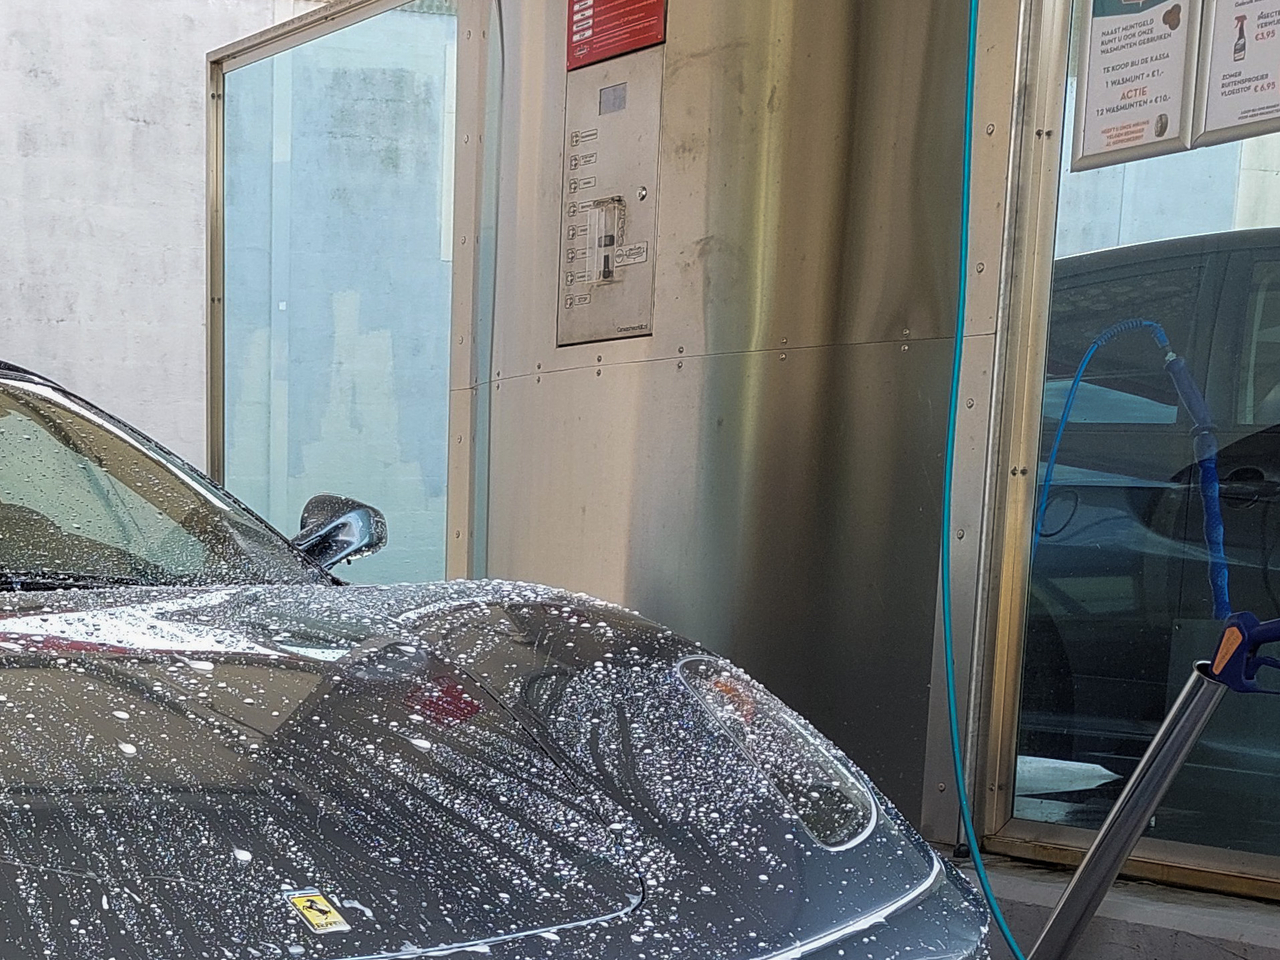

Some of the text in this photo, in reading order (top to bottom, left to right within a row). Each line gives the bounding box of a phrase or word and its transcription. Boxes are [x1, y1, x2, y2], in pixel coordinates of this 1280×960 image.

[1101, 18, 1154, 37] NAAST MUNTGELD
[1100, 36, 1117, 47] KUNT
[1123, 32, 1137, 41] OOK
[1137, 27, 1154, 37] ONZE
[1100, 32, 1172, 55] WASMUNTEN GEBRUIKEN
[1111, 61, 1129, 72] KOOP
[1130, 59, 1140, 67] BIJ
[1140, 57, 1149, 65] DE
[1150, 52, 1170, 62] KASSA
[1110, 73, 1145, 87] WASMUNT
[1221, 71, 1242, 81] ZOMER
[1120, 86, 1148, 101] ACTIE
[1096, 109, 1105, 117] 12
[1105, 99, 1148, 114] WASMUNTEN
